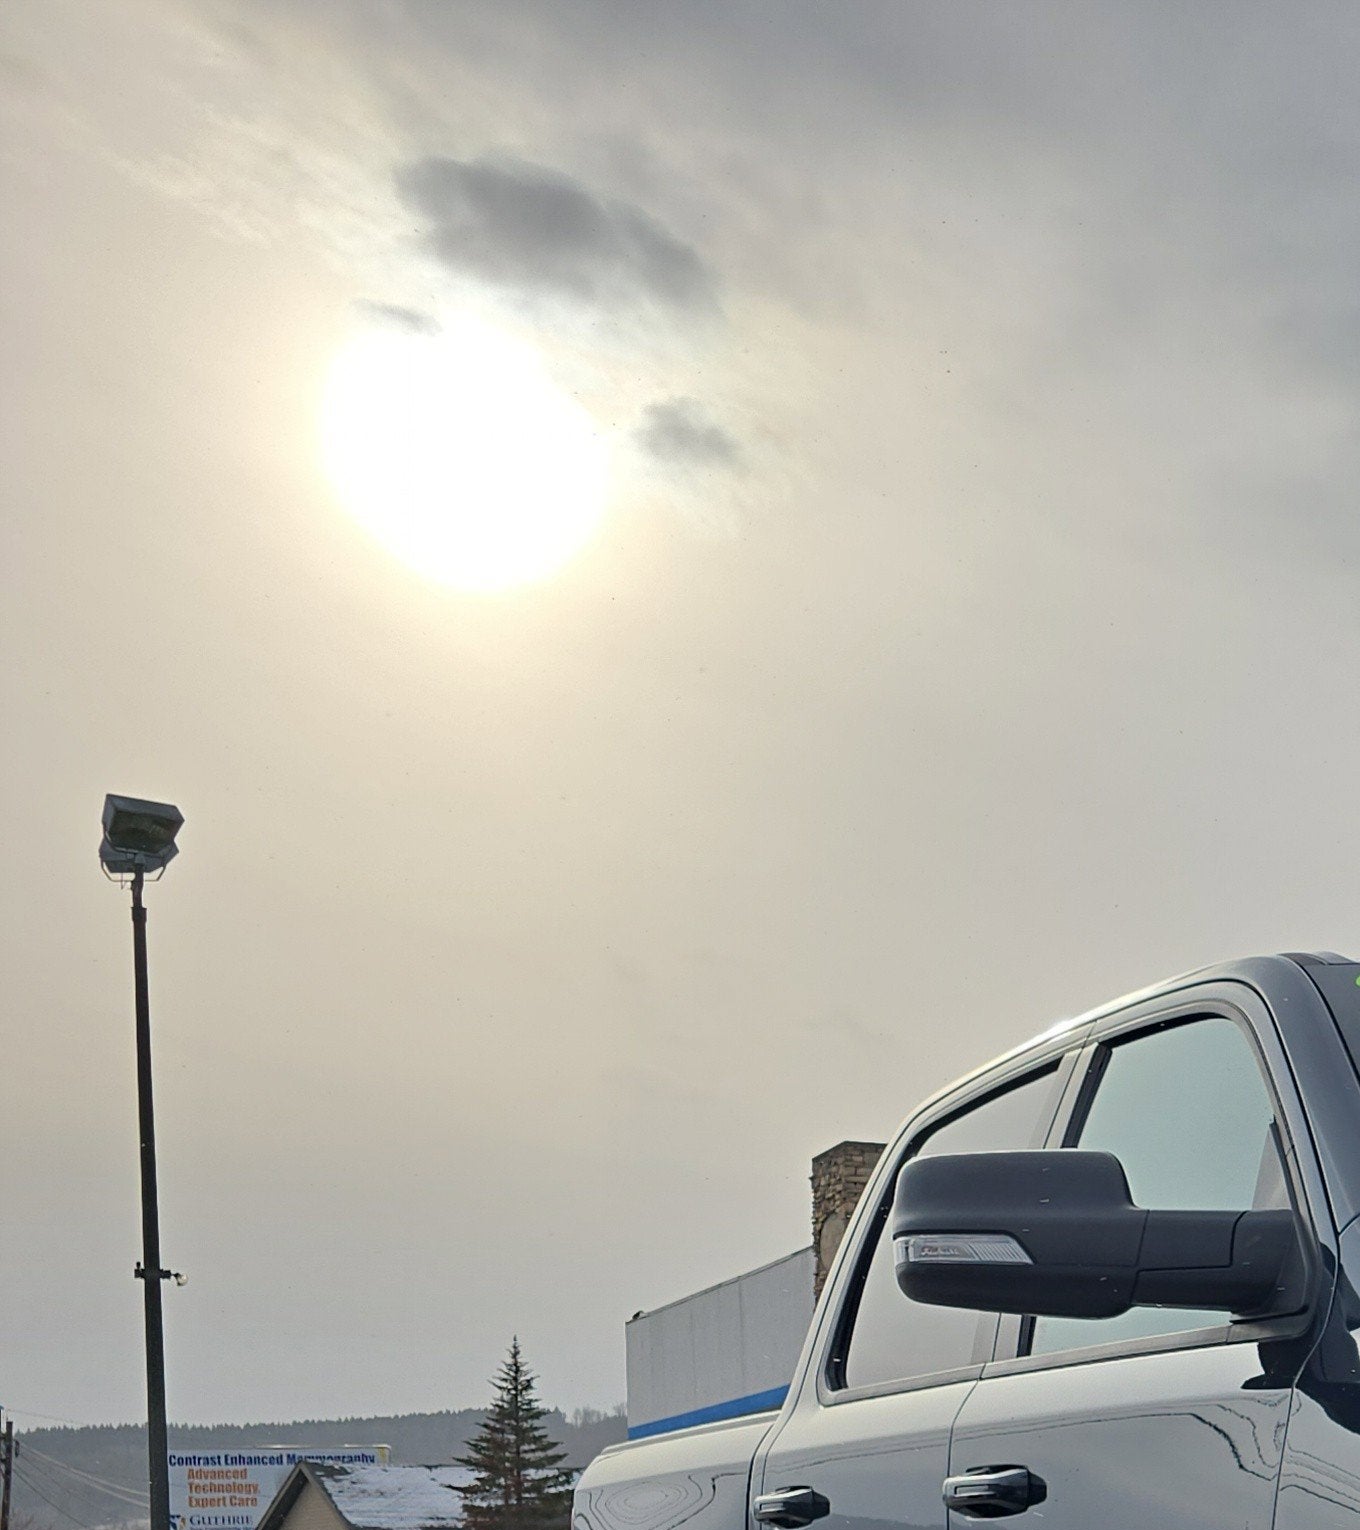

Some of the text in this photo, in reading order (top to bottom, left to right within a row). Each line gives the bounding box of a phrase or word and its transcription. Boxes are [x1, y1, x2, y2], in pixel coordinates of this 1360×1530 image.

[169, 1454, 222, 1467] Contrast
[224, 1454, 283, 1467] Enhanced
[187, 1468, 248, 1480] Advanced
[188, 1495, 258, 1508] Expert Care
